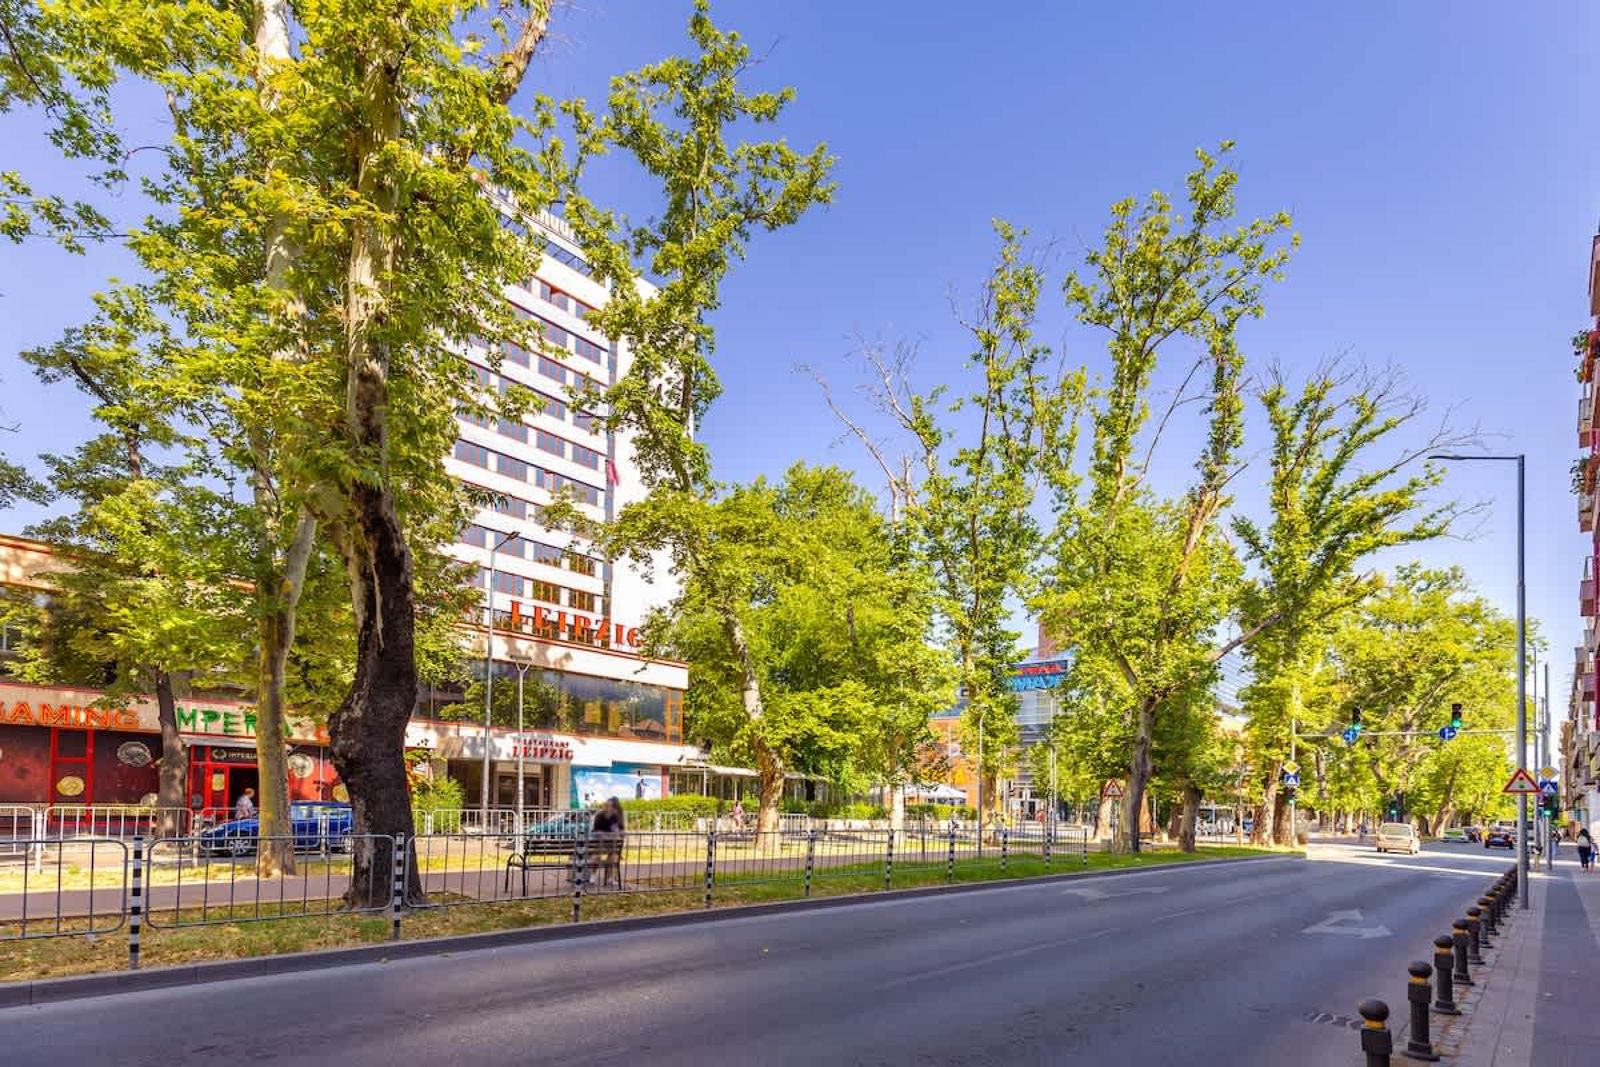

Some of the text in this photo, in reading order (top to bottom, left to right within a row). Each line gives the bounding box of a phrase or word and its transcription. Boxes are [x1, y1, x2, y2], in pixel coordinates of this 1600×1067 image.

[510, 599, 646, 648] LEIPZIG
[0, 701, 140, 731] AMING
[512, 745, 574, 762] LEIPZIG
